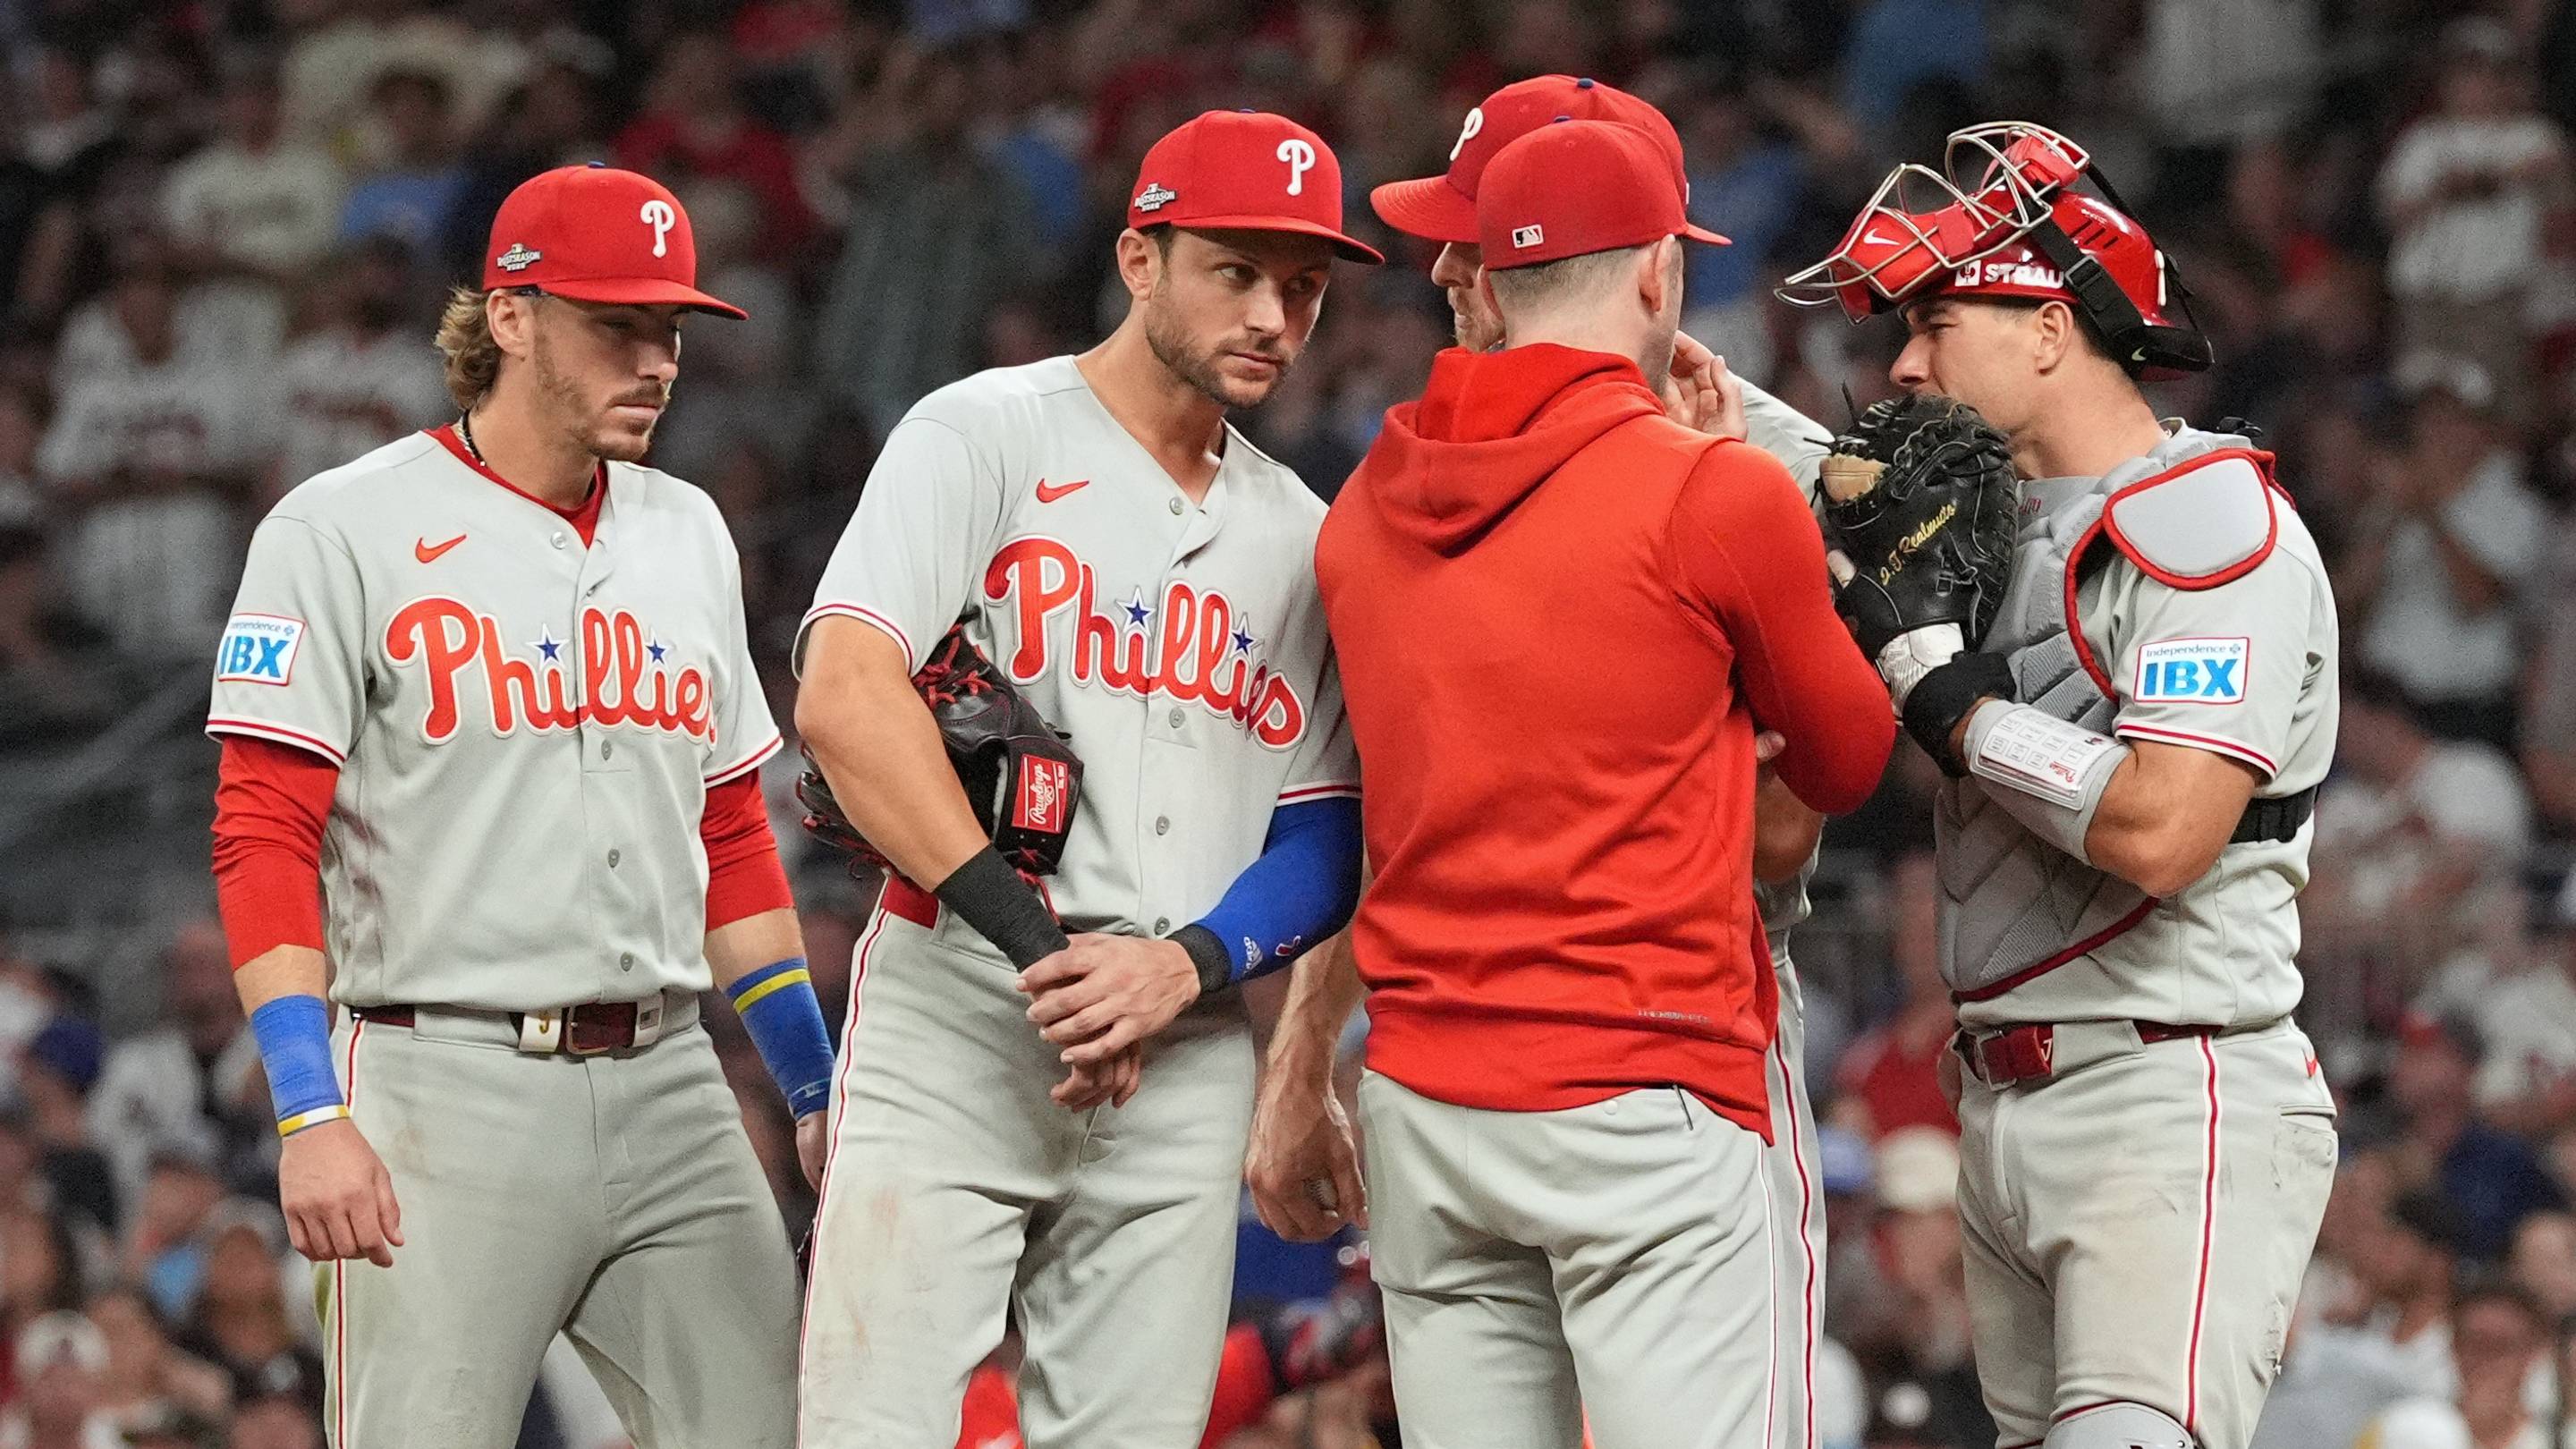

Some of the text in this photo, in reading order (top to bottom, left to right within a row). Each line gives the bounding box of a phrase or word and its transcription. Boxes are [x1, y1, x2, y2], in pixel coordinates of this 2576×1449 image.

[1450, 107, 1484, 161] P
[1276, 139, 1316, 196] P
[640, 199, 675, 258] P
[219, 635, 290, 678] IBX
[983, 534, 1307, 750] Phillies
[2146, 643, 2227, 657] Independence
[384, 594, 716, 750] Phillie
[2143, 658, 2239, 697] IBX
[1030, 763, 1052, 825] Rawlings
